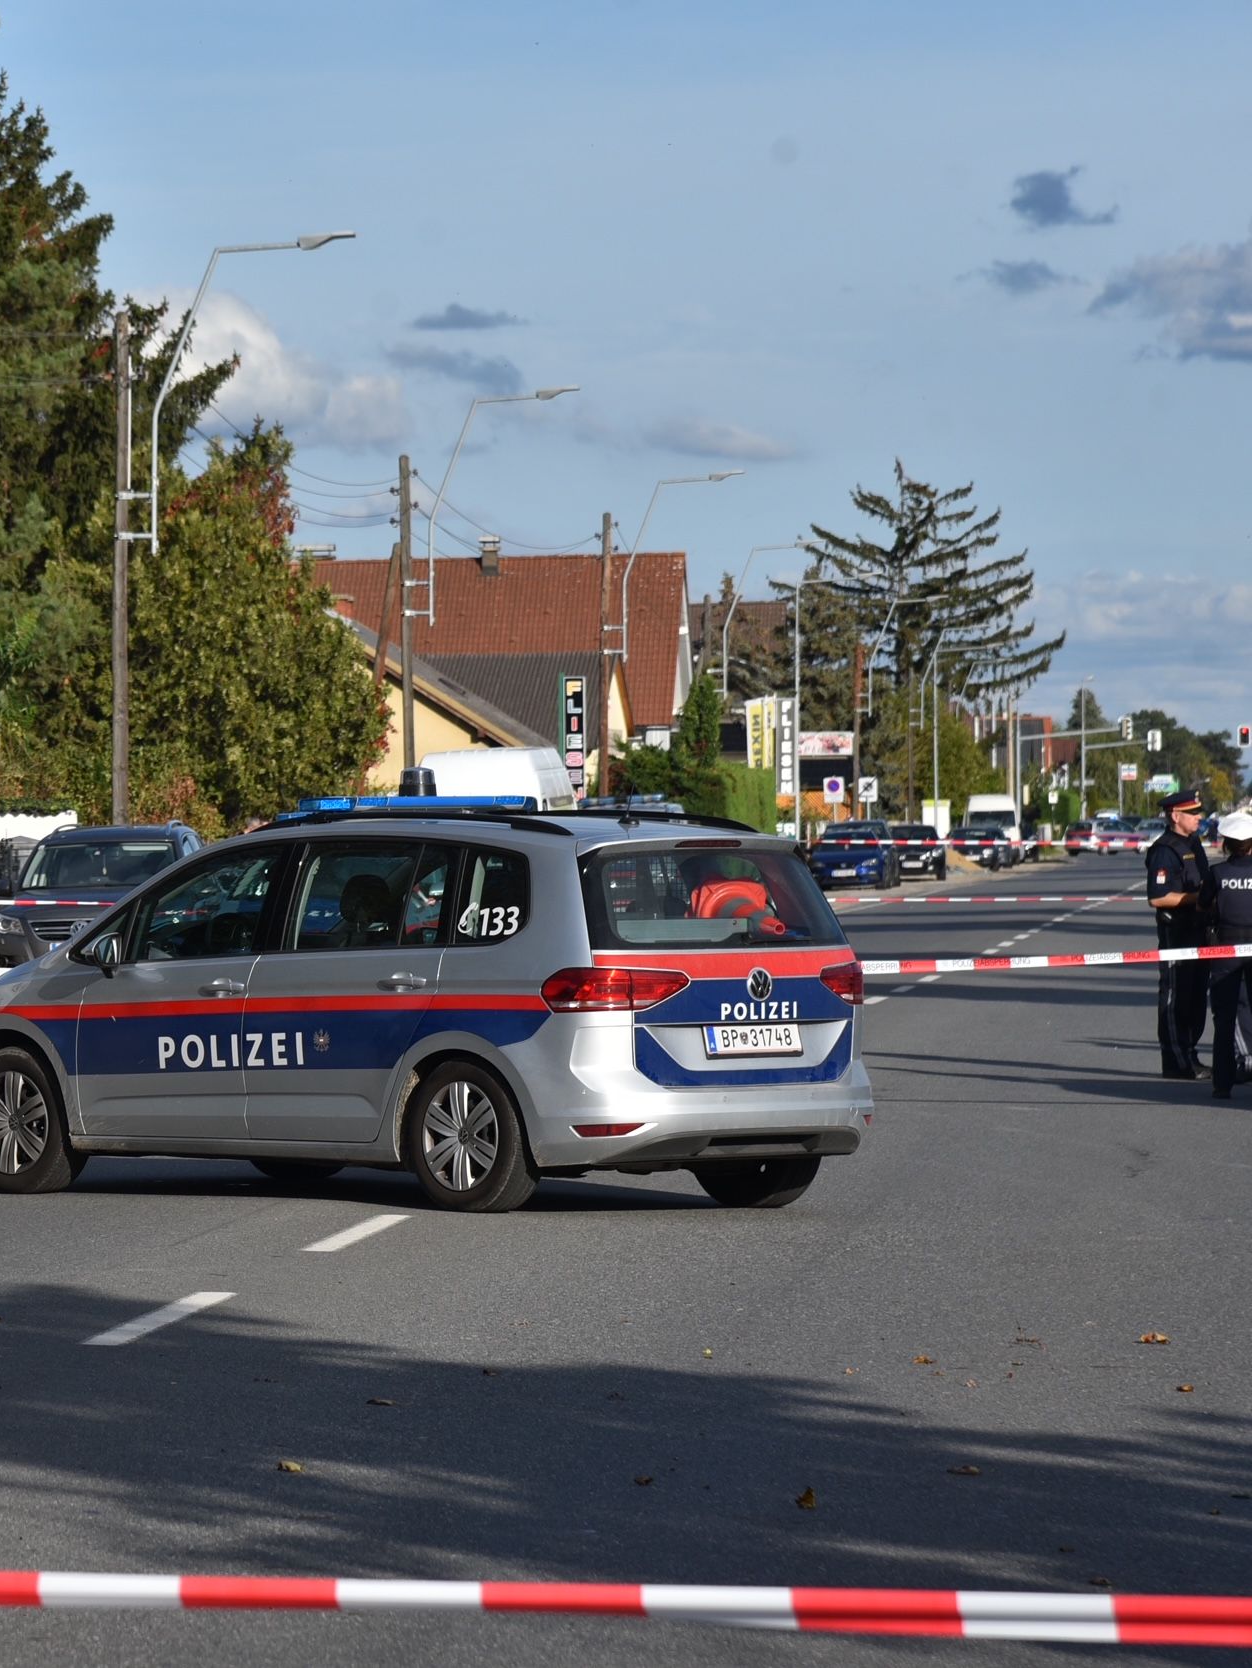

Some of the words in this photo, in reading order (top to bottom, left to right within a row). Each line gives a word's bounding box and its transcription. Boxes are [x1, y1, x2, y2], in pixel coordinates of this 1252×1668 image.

[780, 701, 793, 794] FLIESEN
[479, 906, 520, 936] 133
[720, 1001, 798, 1020] POLIZEI
[158, 1032, 304, 1069] POLIZEI
[721, 1029, 739, 1047] BP
[749, 1028, 792, 1047] 31748
